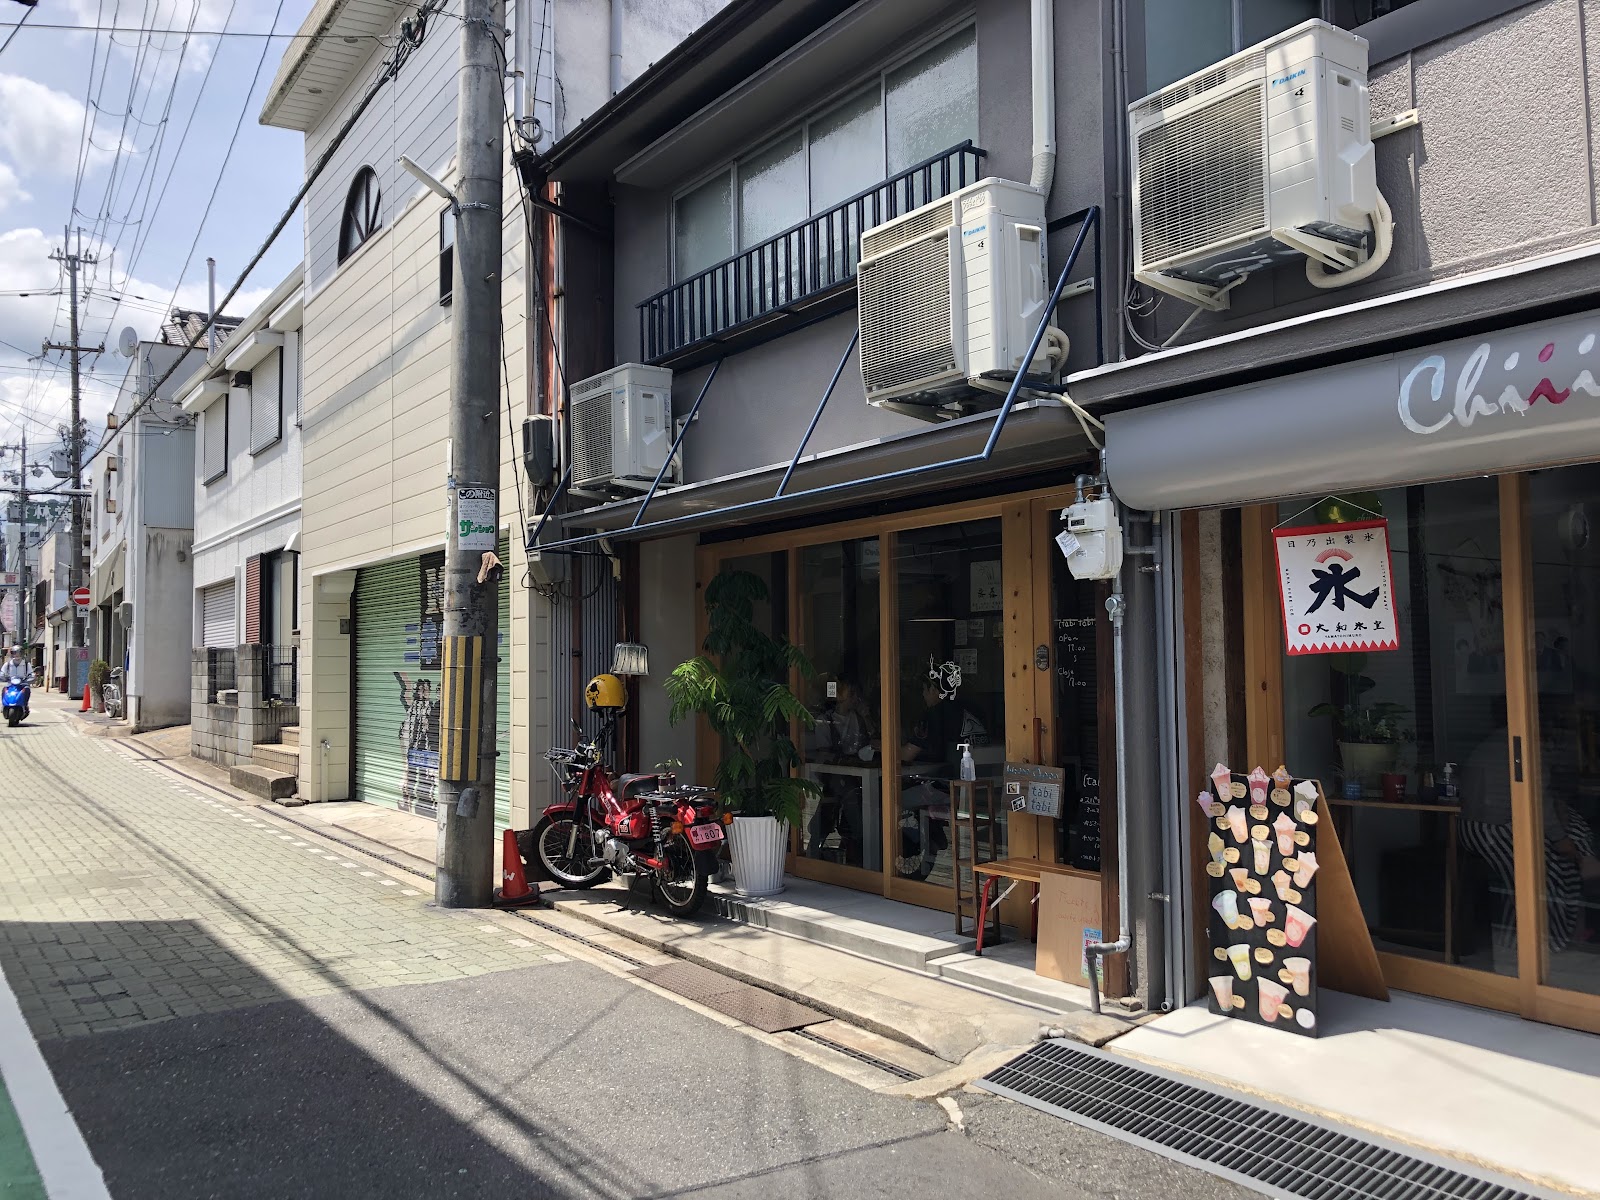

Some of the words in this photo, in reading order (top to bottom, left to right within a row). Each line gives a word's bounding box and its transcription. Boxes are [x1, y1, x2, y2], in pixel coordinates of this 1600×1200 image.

[1279, 69, 1306, 85] DAIKIN
[1303, 563, 1380, 616] 氷
[1031, 785, 1053, 799] tabi
[1031, 798, 1052, 812] tabi
